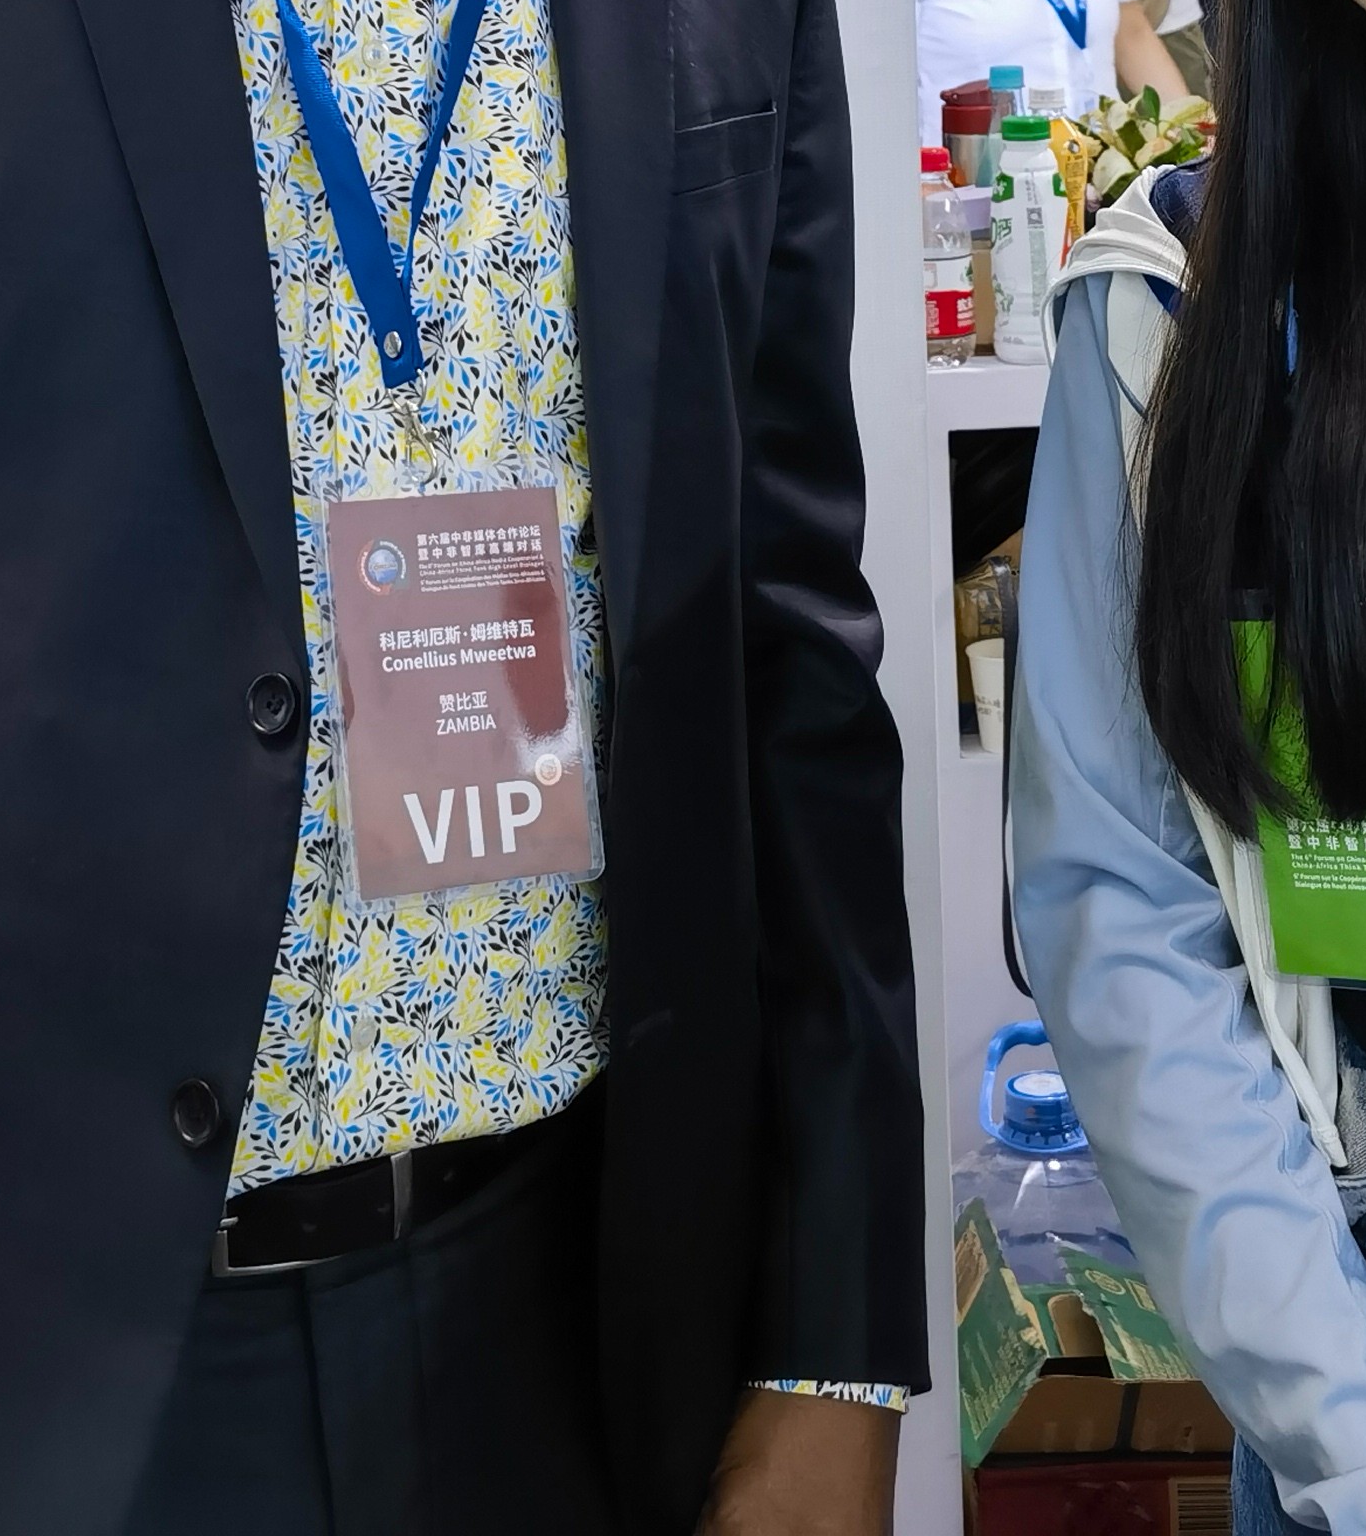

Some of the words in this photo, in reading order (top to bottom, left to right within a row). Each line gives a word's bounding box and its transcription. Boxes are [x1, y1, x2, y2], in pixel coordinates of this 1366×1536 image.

[379, 618, 535, 651] 科尼利厄斯·姆维特瓦
[381, 651, 458, 674] Conellius
[460, 642, 536, 666] Mweetwa
[439, 690, 488, 713] 赞比亚
[436, 713, 497, 736] ZAMBIA
[403, 779, 543, 864] VIP
